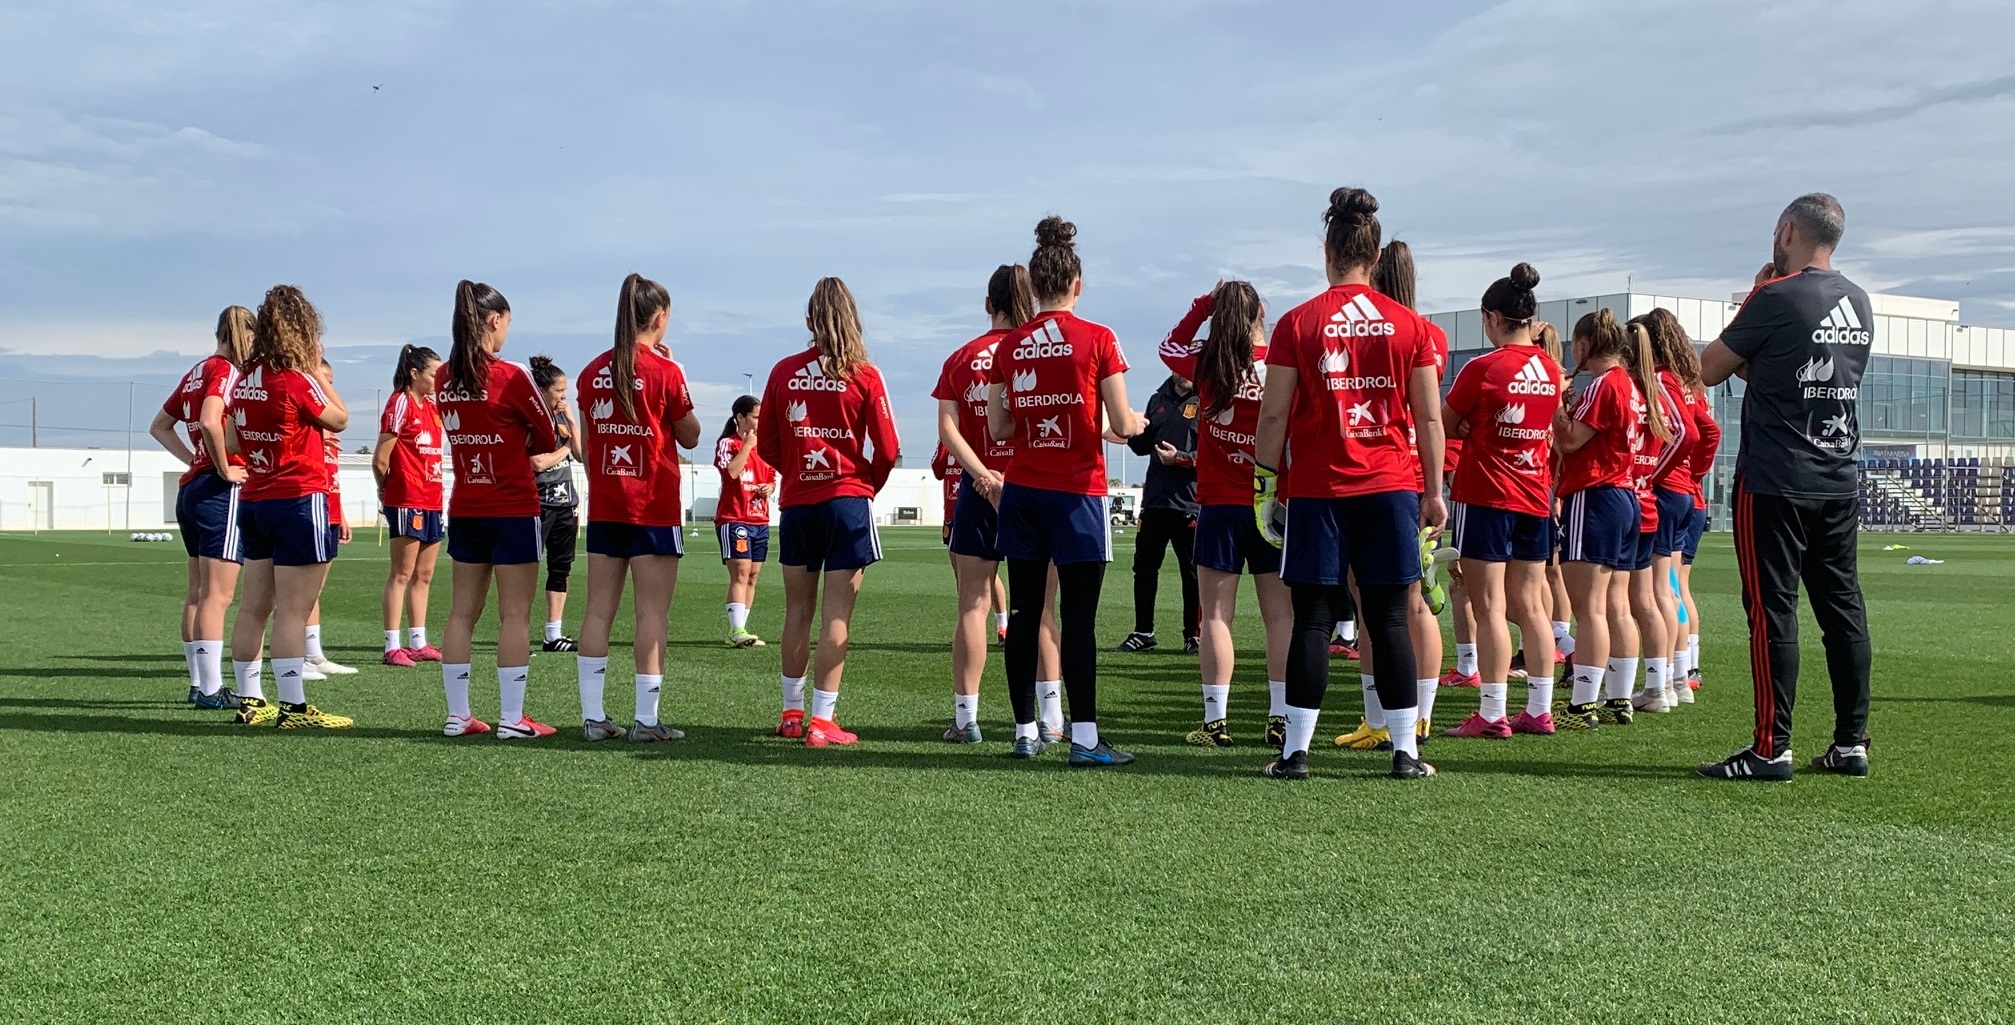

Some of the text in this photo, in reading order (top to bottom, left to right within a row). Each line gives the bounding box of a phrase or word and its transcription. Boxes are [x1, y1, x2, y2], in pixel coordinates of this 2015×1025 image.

[1324, 319, 1396, 338] adidas
[1812, 324, 1870, 346] adidas
[1012, 341, 1074, 361] adidas
[788, 375, 848, 393] adidas
[1508, 379, 1556, 396] adidas
[233, 385, 269, 401] adidas
[1014, 392, 1085, 409] IBERDROLA
[597, 423, 655, 438] IBERDROLA
[1209, 424, 1256, 446] IBERDR
[1498, 426, 1546, 440] IBERDRO
[450, 433, 505, 446] BERDROLA
[989, 448, 1014, 457] CaixaB
